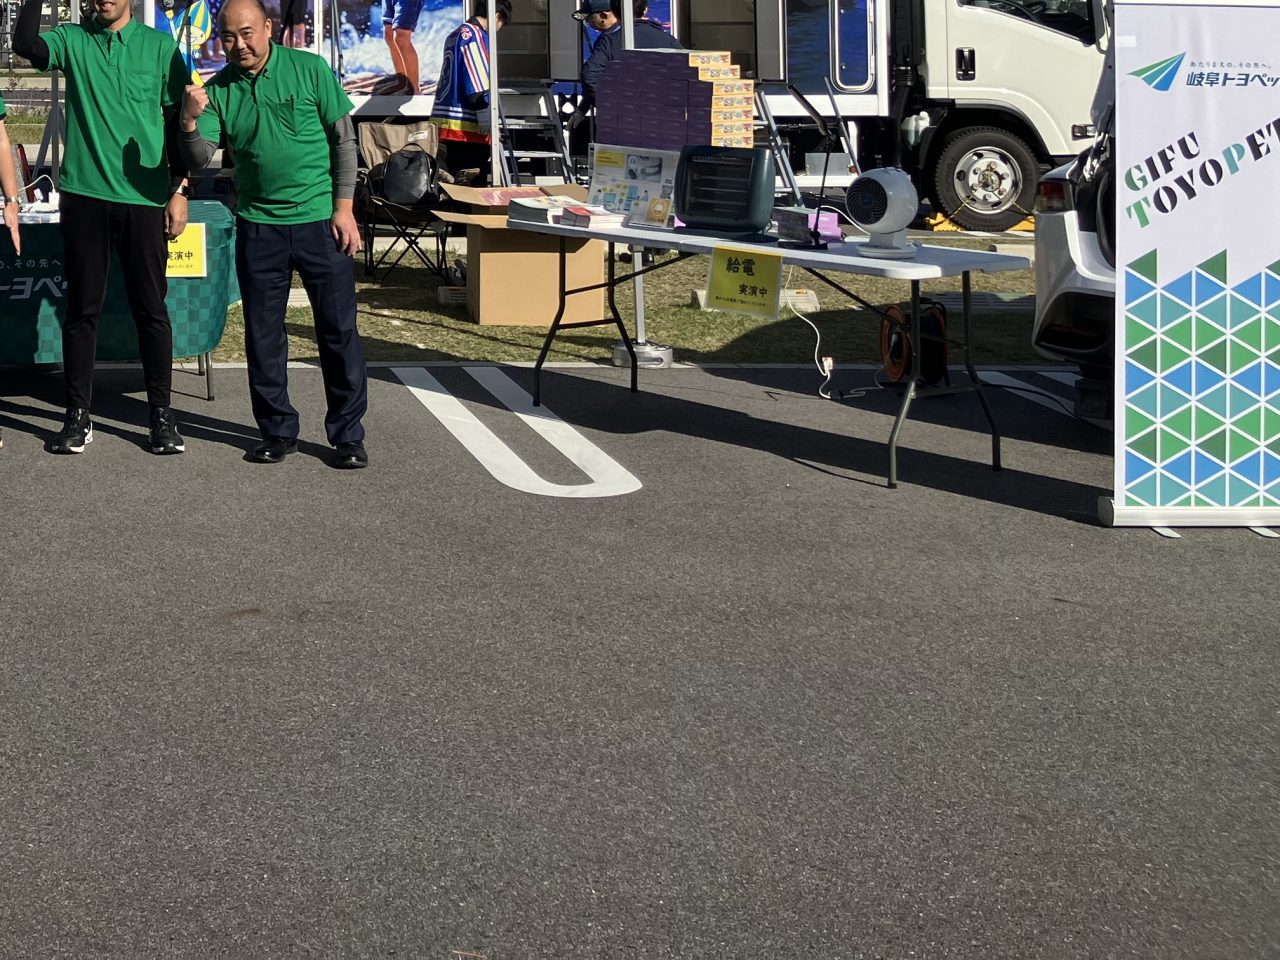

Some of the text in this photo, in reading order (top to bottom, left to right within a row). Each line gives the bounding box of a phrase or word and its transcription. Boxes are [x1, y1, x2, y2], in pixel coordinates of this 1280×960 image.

[1124, 131, 1201, 192] GIFU
[726, 257, 755, 276] 給電
[739, 284, 768, 298] 実演中
